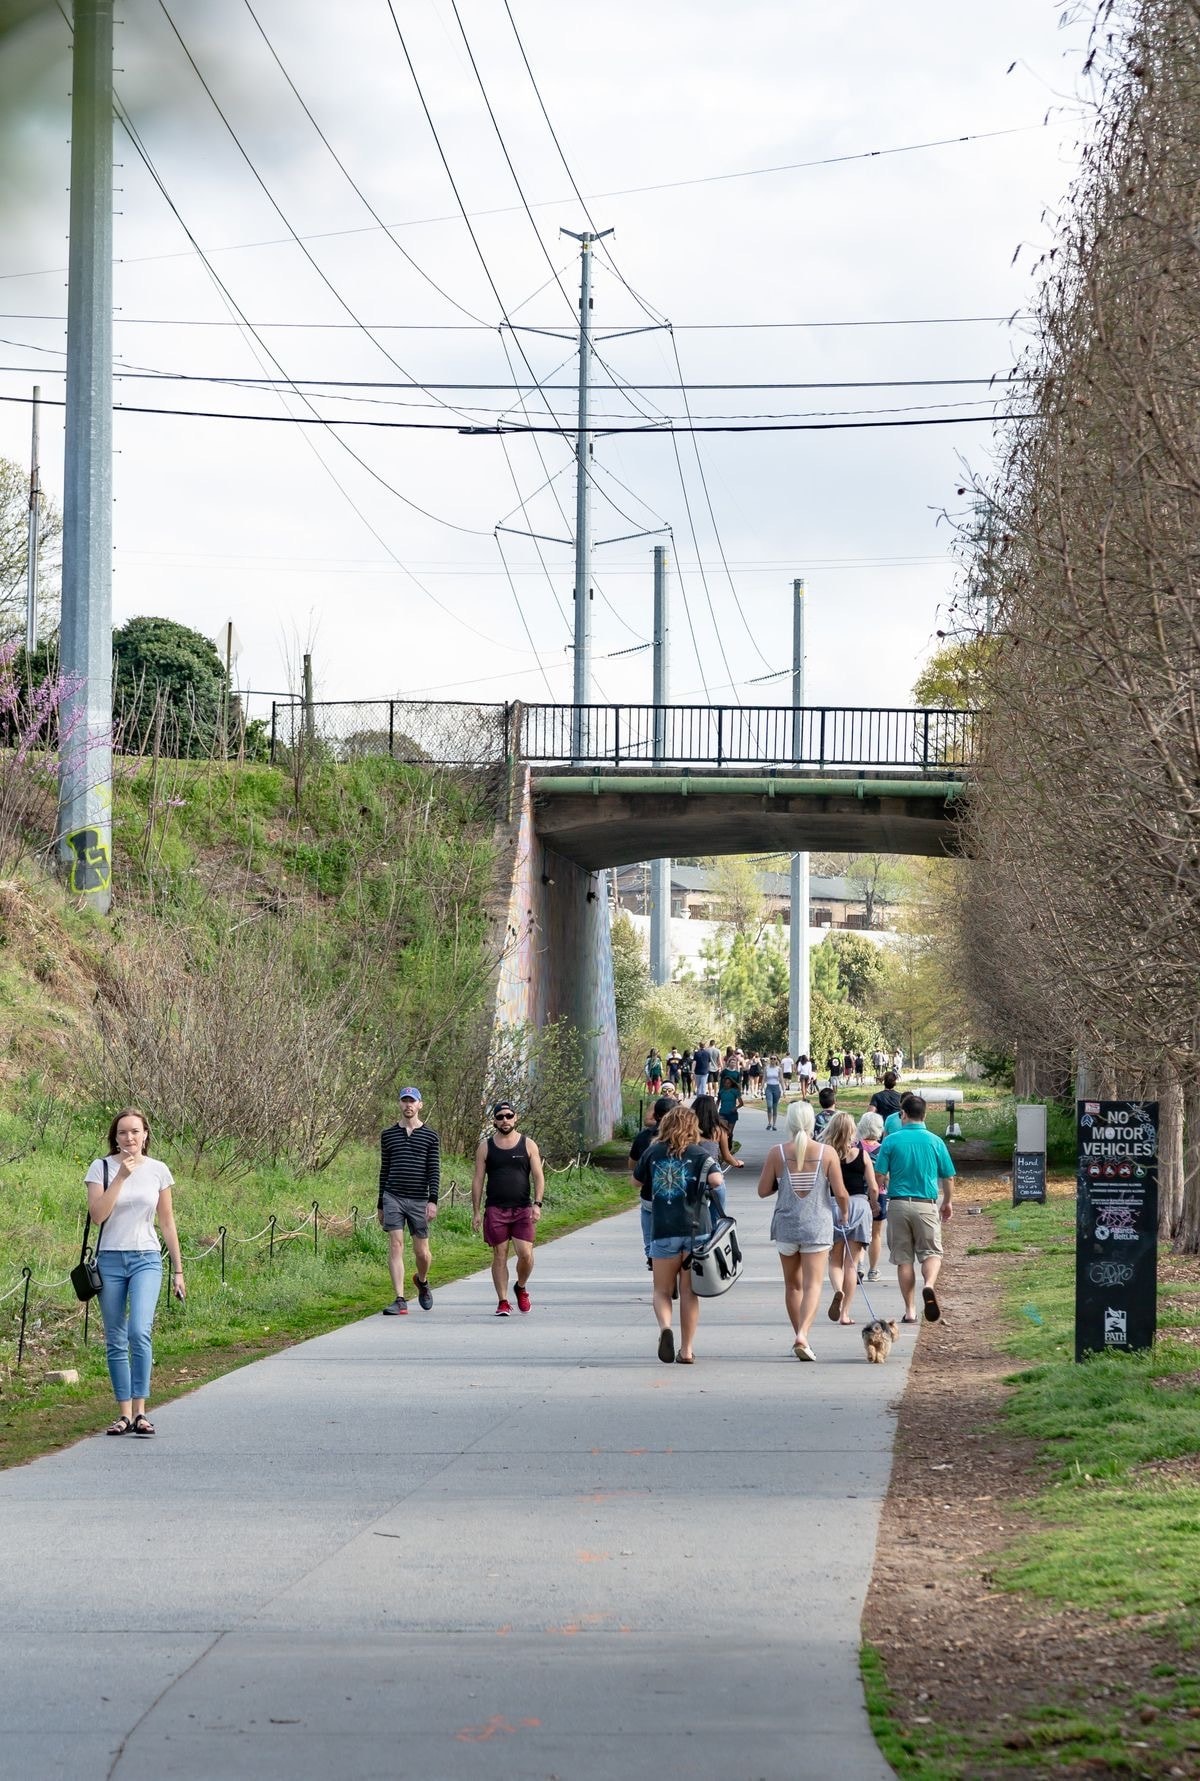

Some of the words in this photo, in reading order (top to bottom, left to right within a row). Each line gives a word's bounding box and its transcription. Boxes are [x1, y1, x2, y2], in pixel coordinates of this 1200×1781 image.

[1107, 1111, 1129, 1124] NO
[1092, 1127, 1144, 1140] MOTOR
[1083, 1142, 1152, 1156] VEHICLES
[1017, 1157, 1037, 1166] Hand
[1104, 1332, 1127, 1341] PATH
